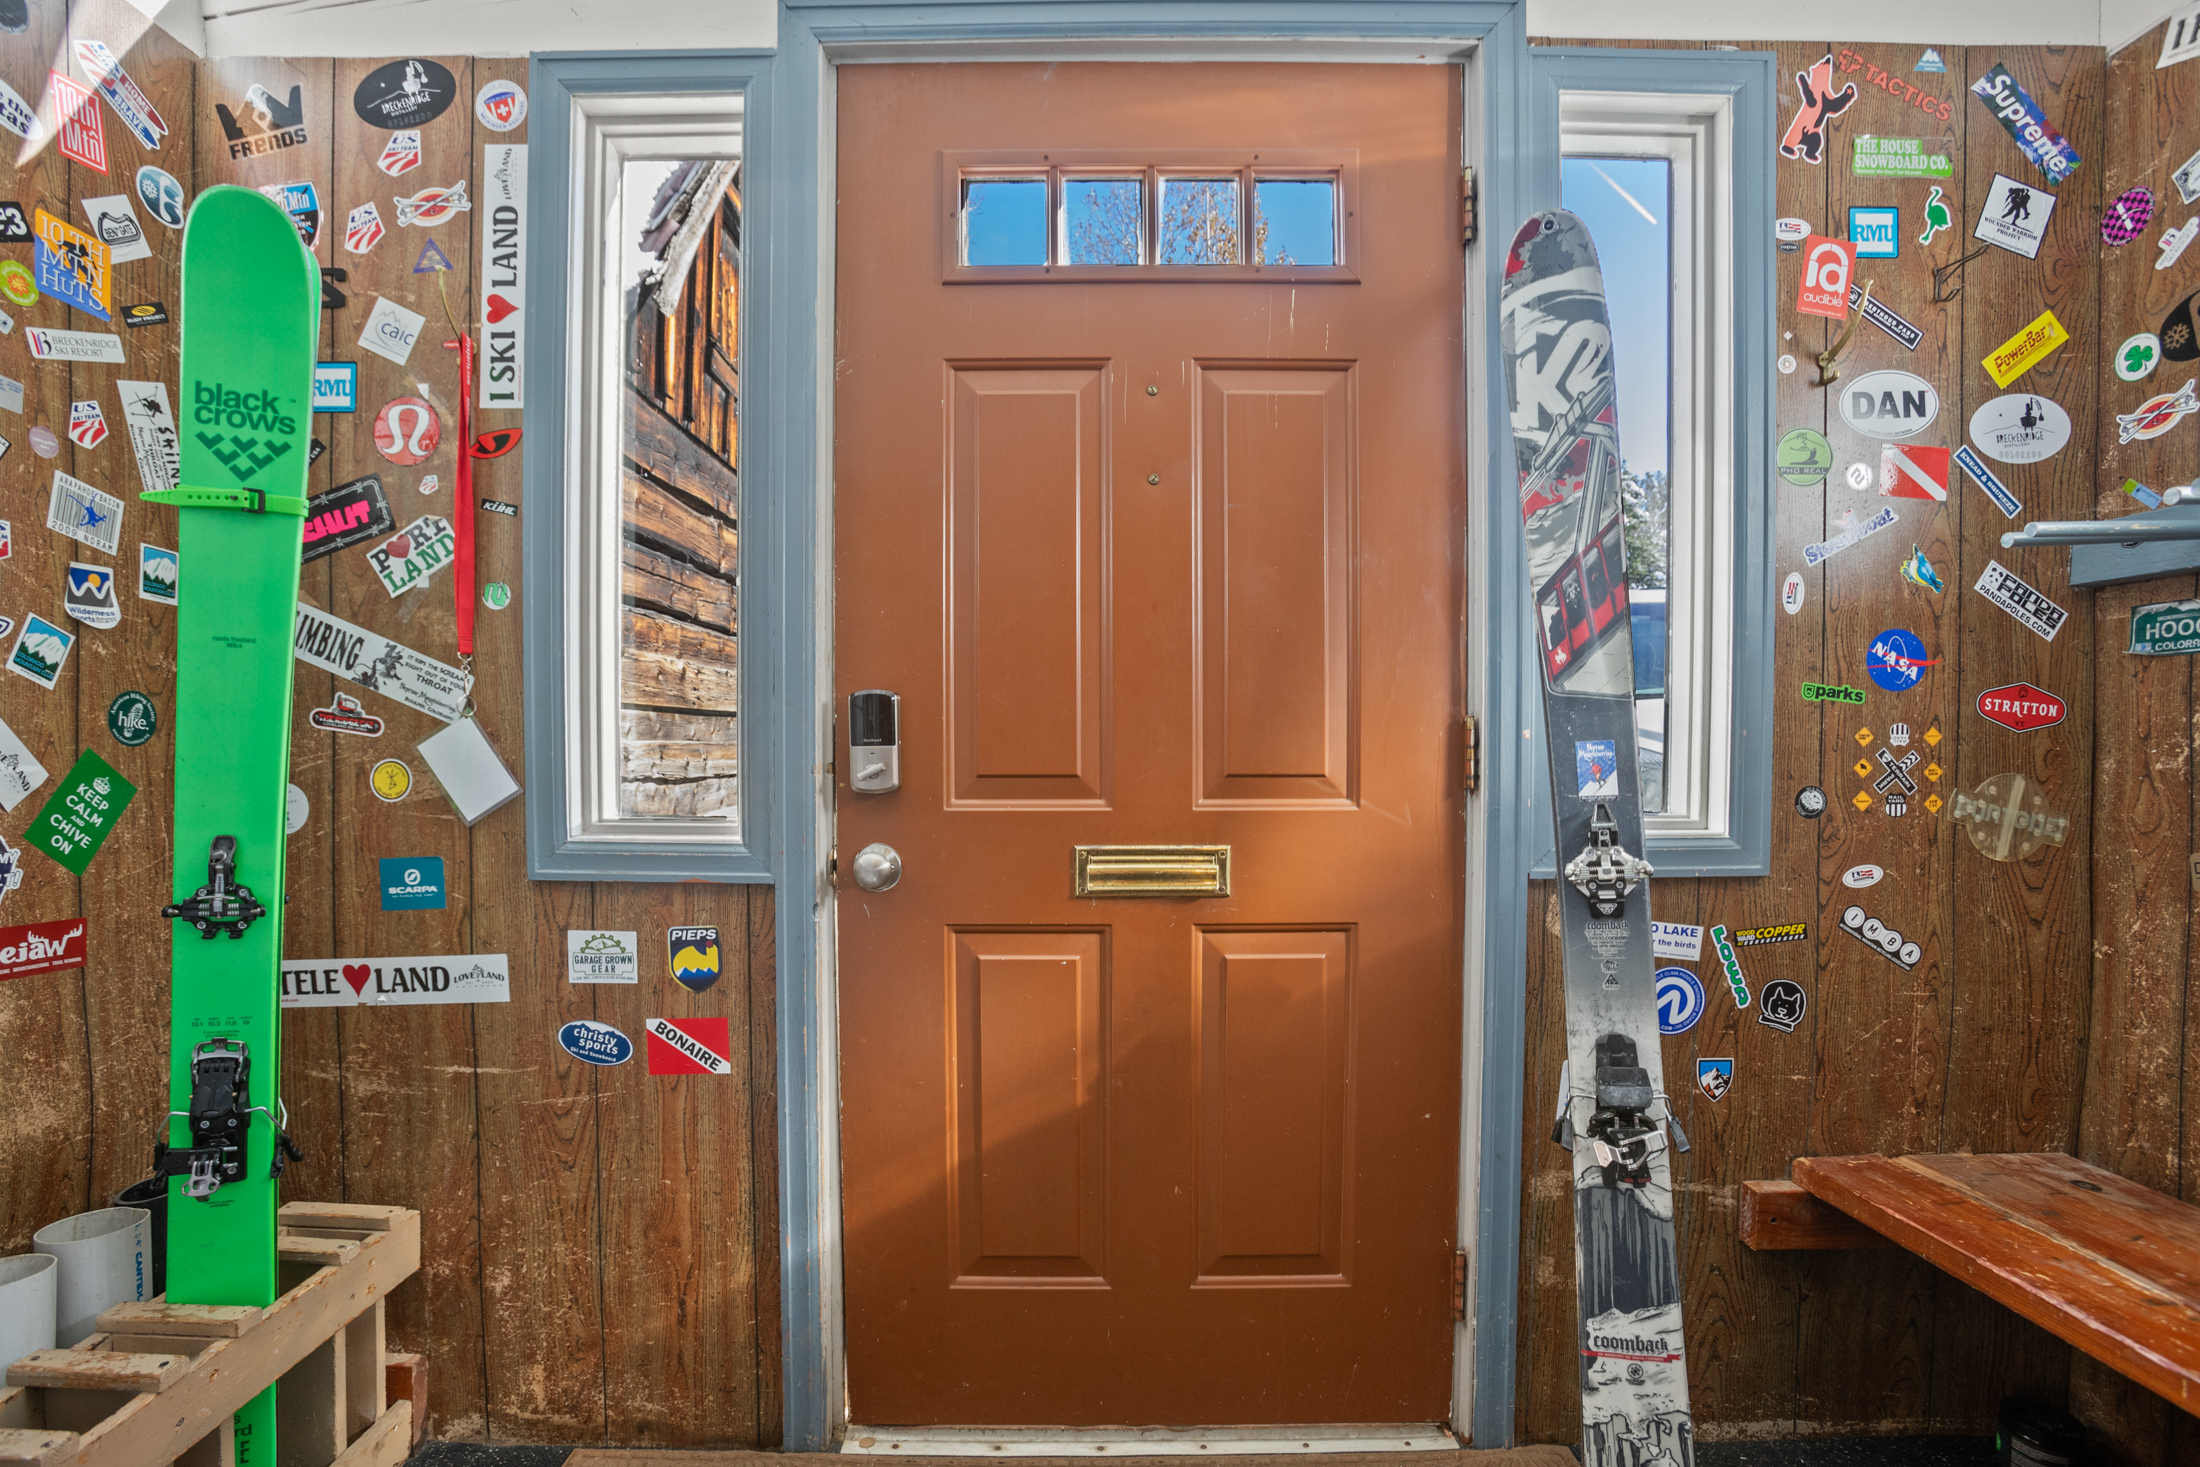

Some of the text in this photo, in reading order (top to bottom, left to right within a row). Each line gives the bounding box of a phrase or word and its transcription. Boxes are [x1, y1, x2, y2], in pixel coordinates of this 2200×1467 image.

[124, 81, 151, 115] HOME
[1865, 63, 1952, 121] TACTICS
[8, 97, 32, 123] the
[381, 92, 431, 115] BRECKENRIDGE
[391, 106, 418, 117] DISTILLERY
[113, 94, 146, 136] BRAVE
[1986, 74, 2067, 172] Supreme
[392, 136, 418, 144] US
[1856, 139, 1918, 154] THE HOUSE
[1855, 154, 1949, 170] SNOWBOARD CO.
[351, 209, 373, 224] US
[360, 217, 377, 229] TEAM
[104, 223, 134, 239] BENT GATE
[1856, 225, 1893, 242] RMU
[1984, 217, 2038, 241] WOUNDED WARRIOR
[1996, 228, 2021, 241] PROJECT
[491, 205, 519, 288] LAND
[41, 239, 104, 289] MTN
[41, 262, 104, 310] HUTS
[1804, 292, 1843, 307] audible
[52, 336, 119, 350] BRECKENRIDGE
[55, 347, 103, 357] SKI RESORT
[1994, 326, 2046, 374] PowerBar
[489, 330, 516, 402] I SKI
[195, 380, 279, 414] black
[314, 379, 352, 397] RMU
[74, 402, 97, 413] US
[1852, 390, 1926, 419] DAN
[194, 405, 296, 436] crows
[1997, 431, 2043, 444] BRECKENRIDGE
[1999, 450, 2042, 459] COLORADO
[1960, 451, 2016, 514] KNEAD & SQUEEZE
[60, 475, 120, 510] ARAPAHOE BASIN
[482, 501, 518, 516] KÜHL
[51, 520, 113, 552] 2009 NORAM
[383, 533, 454, 593] LAND
[1999, 583, 2060, 631] POLES
[2003, 573, 2065, 623] PANDA
[68, 606, 115, 617] Wilderness
[1979, 584, 2051, 639] PANDAPOLES.COM
[16, 650, 45, 668] COLORADO
[428, 663, 438, 672] THE
[1871, 640, 1919, 682] NASA
[404, 661, 423, 673] RIGHT
[425, 670, 438, 679] OUT
[416, 673, 453, 695] THROAT
[1815, 686, 1864, 703] parks
[427, 706, 454, 721] COLORADO
[1984, 698, 2059, 718] STRATTON
[1878, 774, 1896, 790] PARK
[1888, 762, 1911, 789] TERRAIN
[76, 783, 109, 811] KEEP
[65, 795, 103, 828] CALM
[70, 814, 86, 828] AND
[50, 814, 92, 849] CHIVE
[51, 835, 73, 855] ON
[388, 885, 438, 894] SCARPA
[671, 929, 716, 941] PIEPS
[1663, 925, 1698, 938] LAKE
[1736, 924, 1806, 939] WOOD COPPER
[1658, 938, 1697, 950] the birds
[574, 954, 633, 965] GARAGE GROWN
[1712, 926, 1750, 1006] LOWA
[591, 964, 616, 974] GEAR
[282, 966, 450, 995] TELE LAND
[1679, 972, 1696, 986] PADDLE
[574, 1026, 618, 1045] christy
[579, 1037, 619, 1055] sports
[654, 1020, 722, 1072] BONAIRE
[589, 1051, 617, 1062] Snowboard
[1593, 1334, 1669, 1353] coomback
